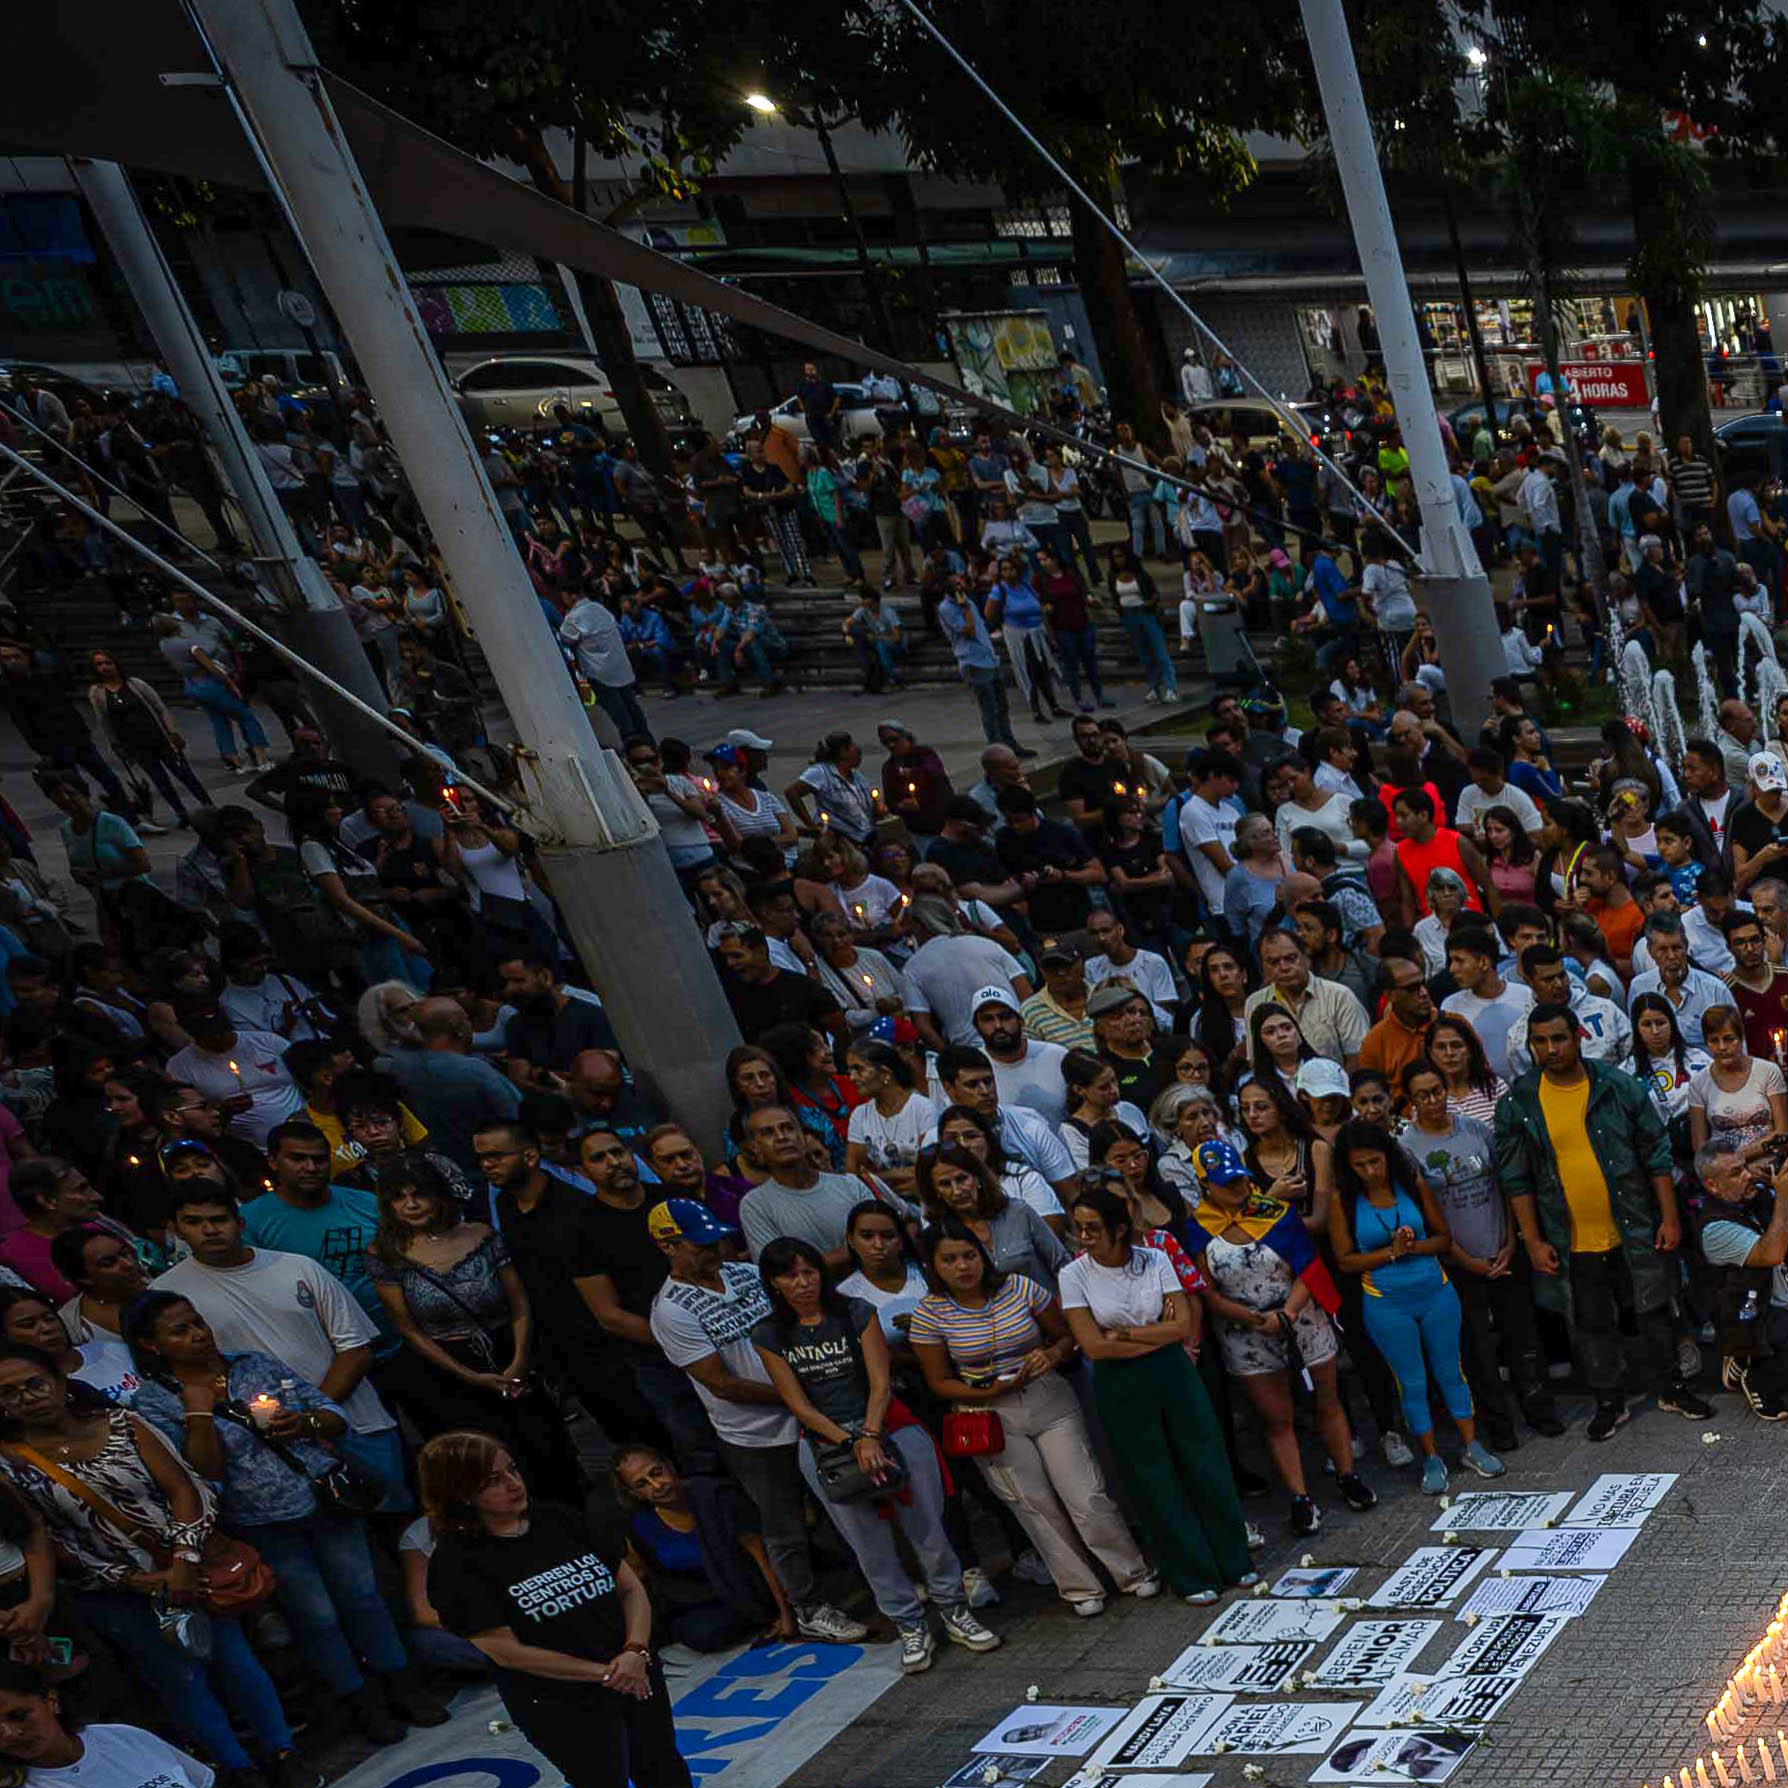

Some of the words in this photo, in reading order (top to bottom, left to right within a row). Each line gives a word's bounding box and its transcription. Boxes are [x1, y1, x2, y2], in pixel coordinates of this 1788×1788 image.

[1565, 367, 1613, 378] ABIERTO
[1582, 382, 1628, 398] HORAS
[508, 1562, 577, 1598] CIERREN
[517, 1568, 595, 1609] CENTROS
[1389, 1566, 1420, 1598] BASTA
[1420, 1555, 1435, 1569] DE
[1424, 1551, 1476, 1602] POLÍTICA
[1449, 1659, 1467, 1674] LA
[1462, 1614, 1510, 1662] TORTURA
[1505, 1616, 1561, 1675] VENEZUELA
